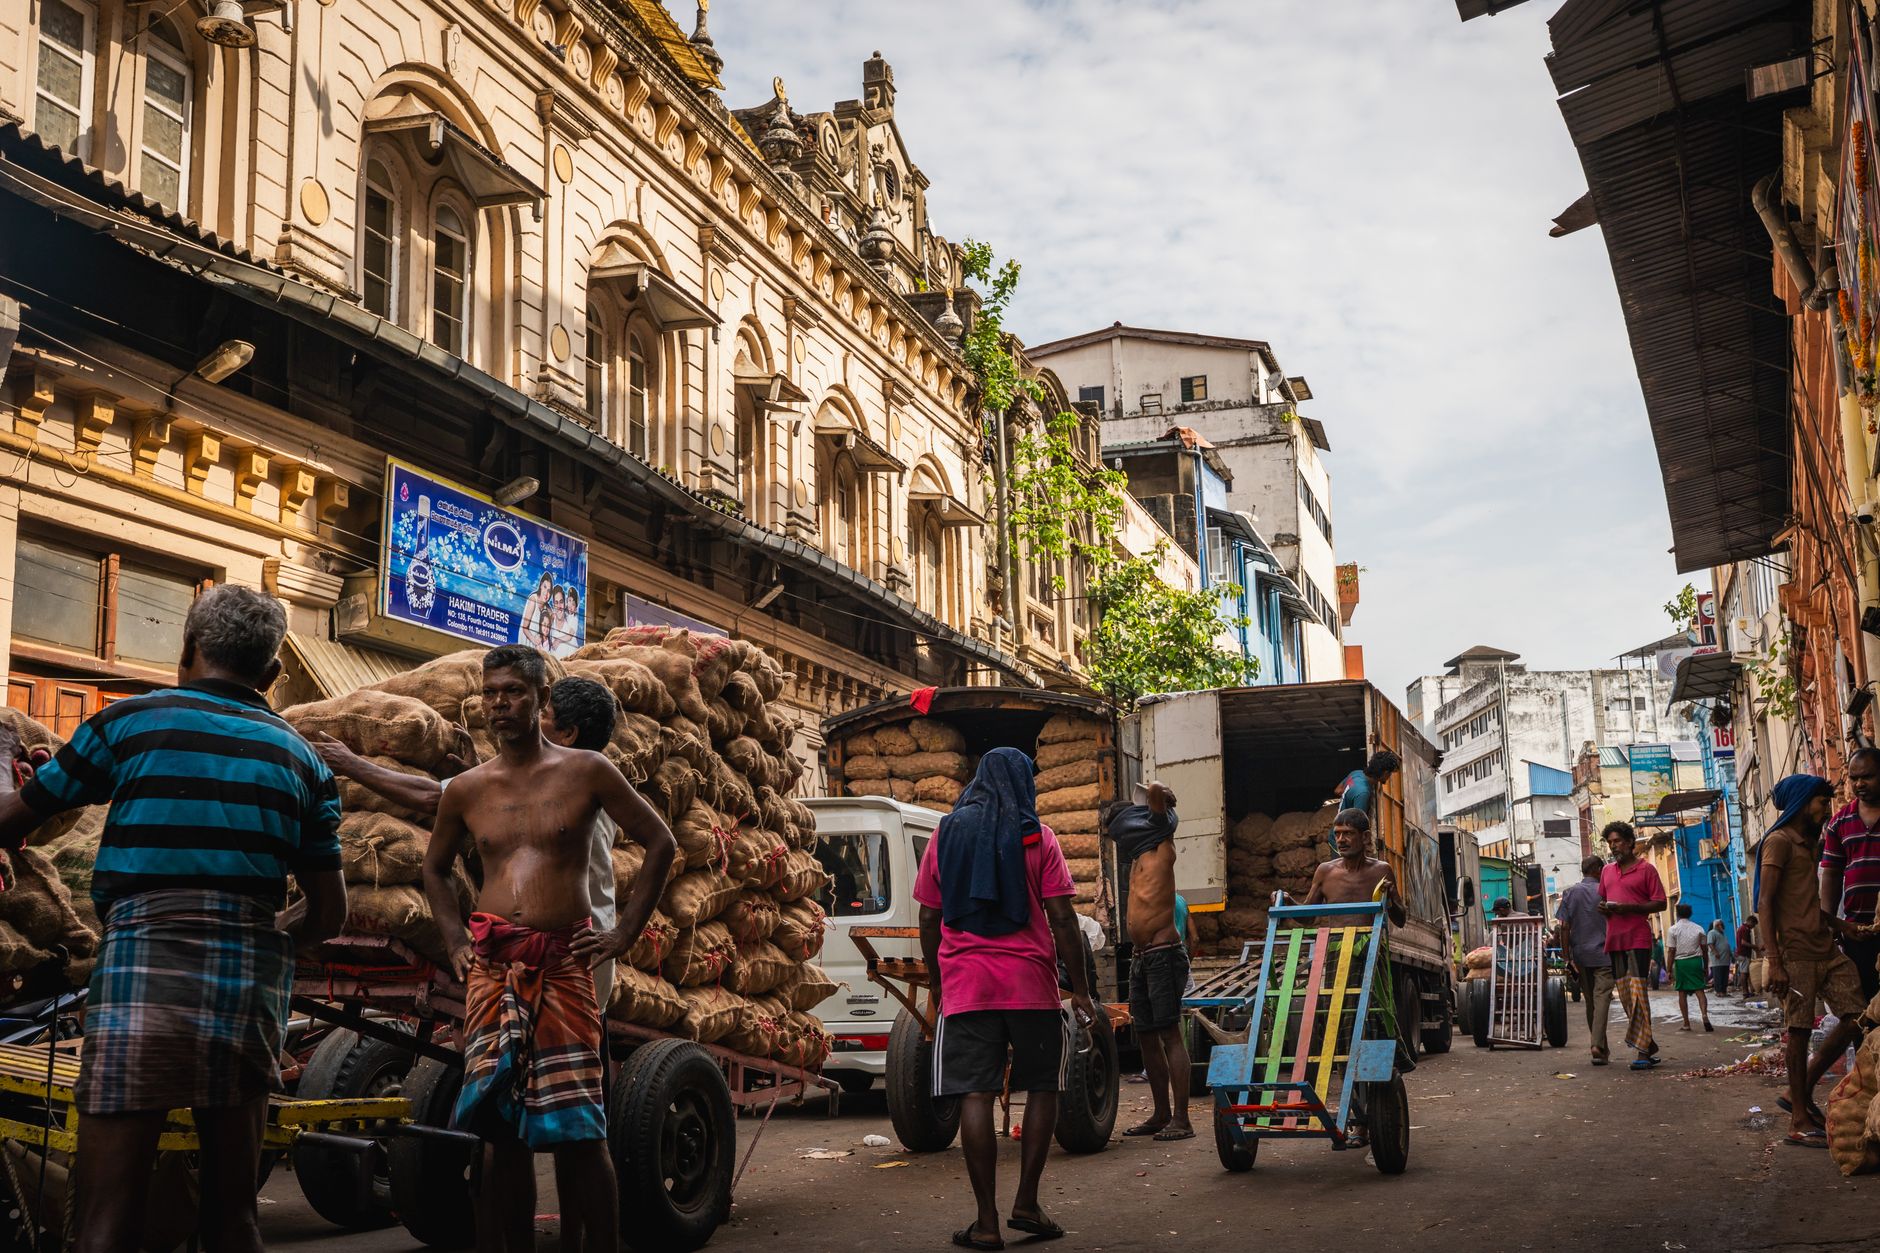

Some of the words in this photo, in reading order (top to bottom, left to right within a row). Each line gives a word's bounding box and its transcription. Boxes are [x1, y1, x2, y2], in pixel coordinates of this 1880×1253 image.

[447, 609, 457, 618] NO:
[467, 615, 482, 625] Fourth
[482, 619, 495, 630] Cross
[495, 623, 509, 634] Street,
[448, 596, 476, 614] HAKIMI
[476, 604, 510, 625] TRADERS
[447, 619, 468, 631] Colombo
